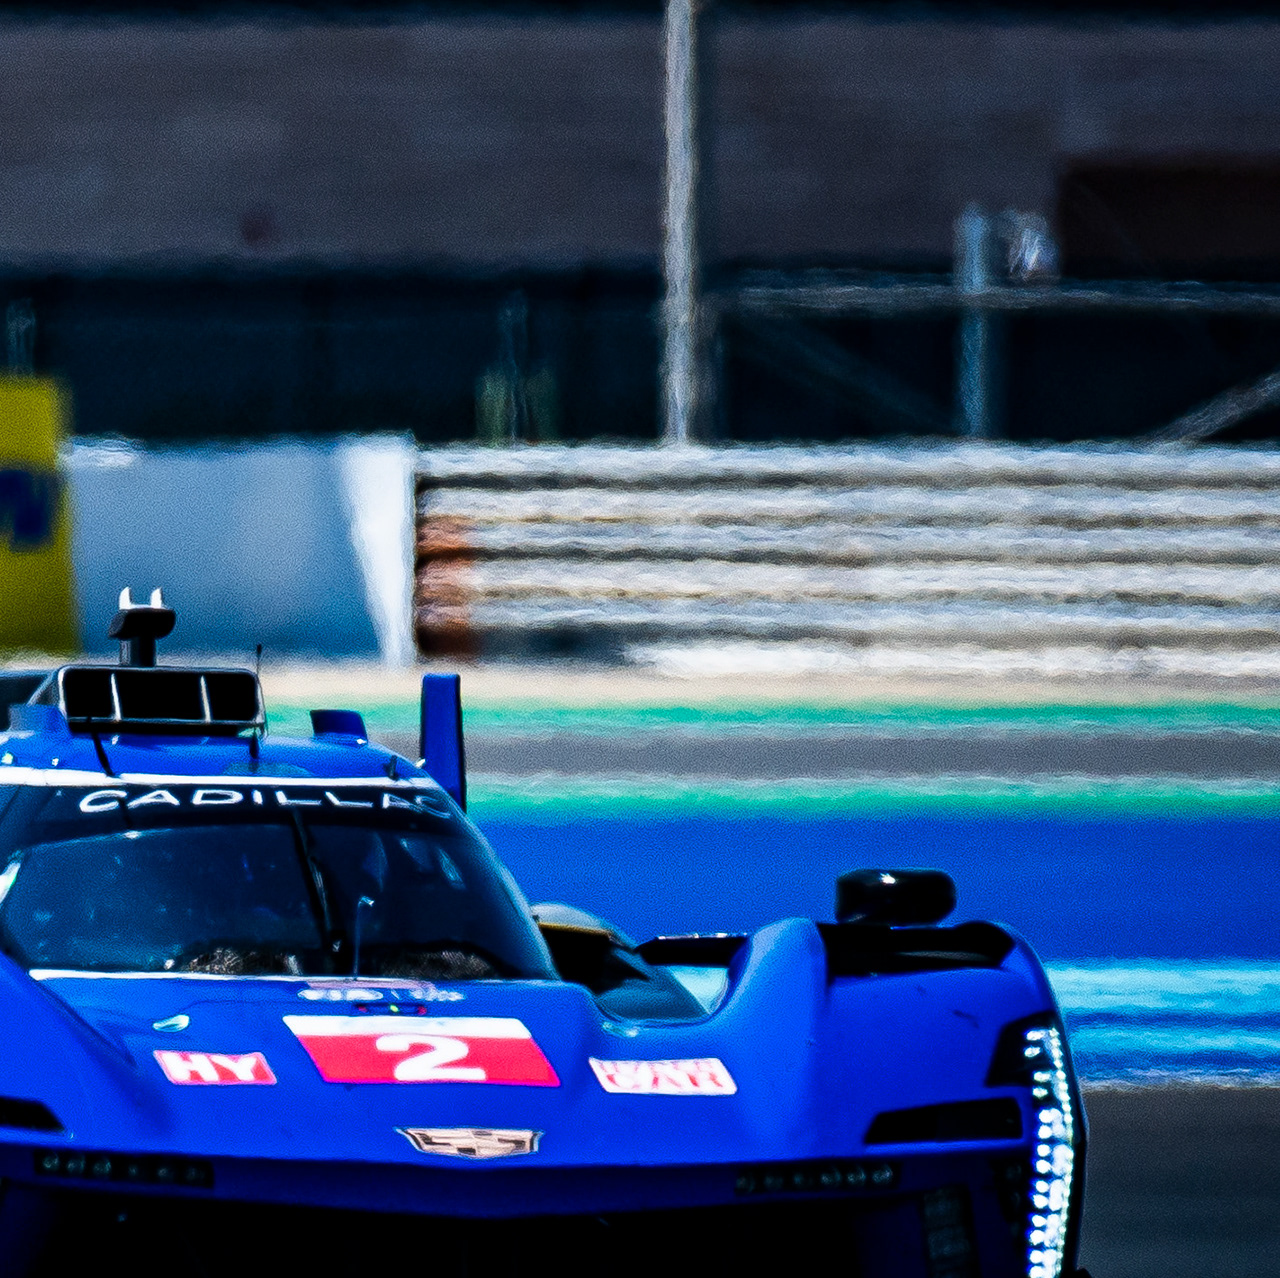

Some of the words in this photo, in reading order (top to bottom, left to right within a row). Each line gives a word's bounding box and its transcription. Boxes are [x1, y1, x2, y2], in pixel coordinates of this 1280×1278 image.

[79, 790, 450, 819] CADILLAC
[161, 1052, 258, 1082] HY
[376, 1034, 486, 1081] 2
